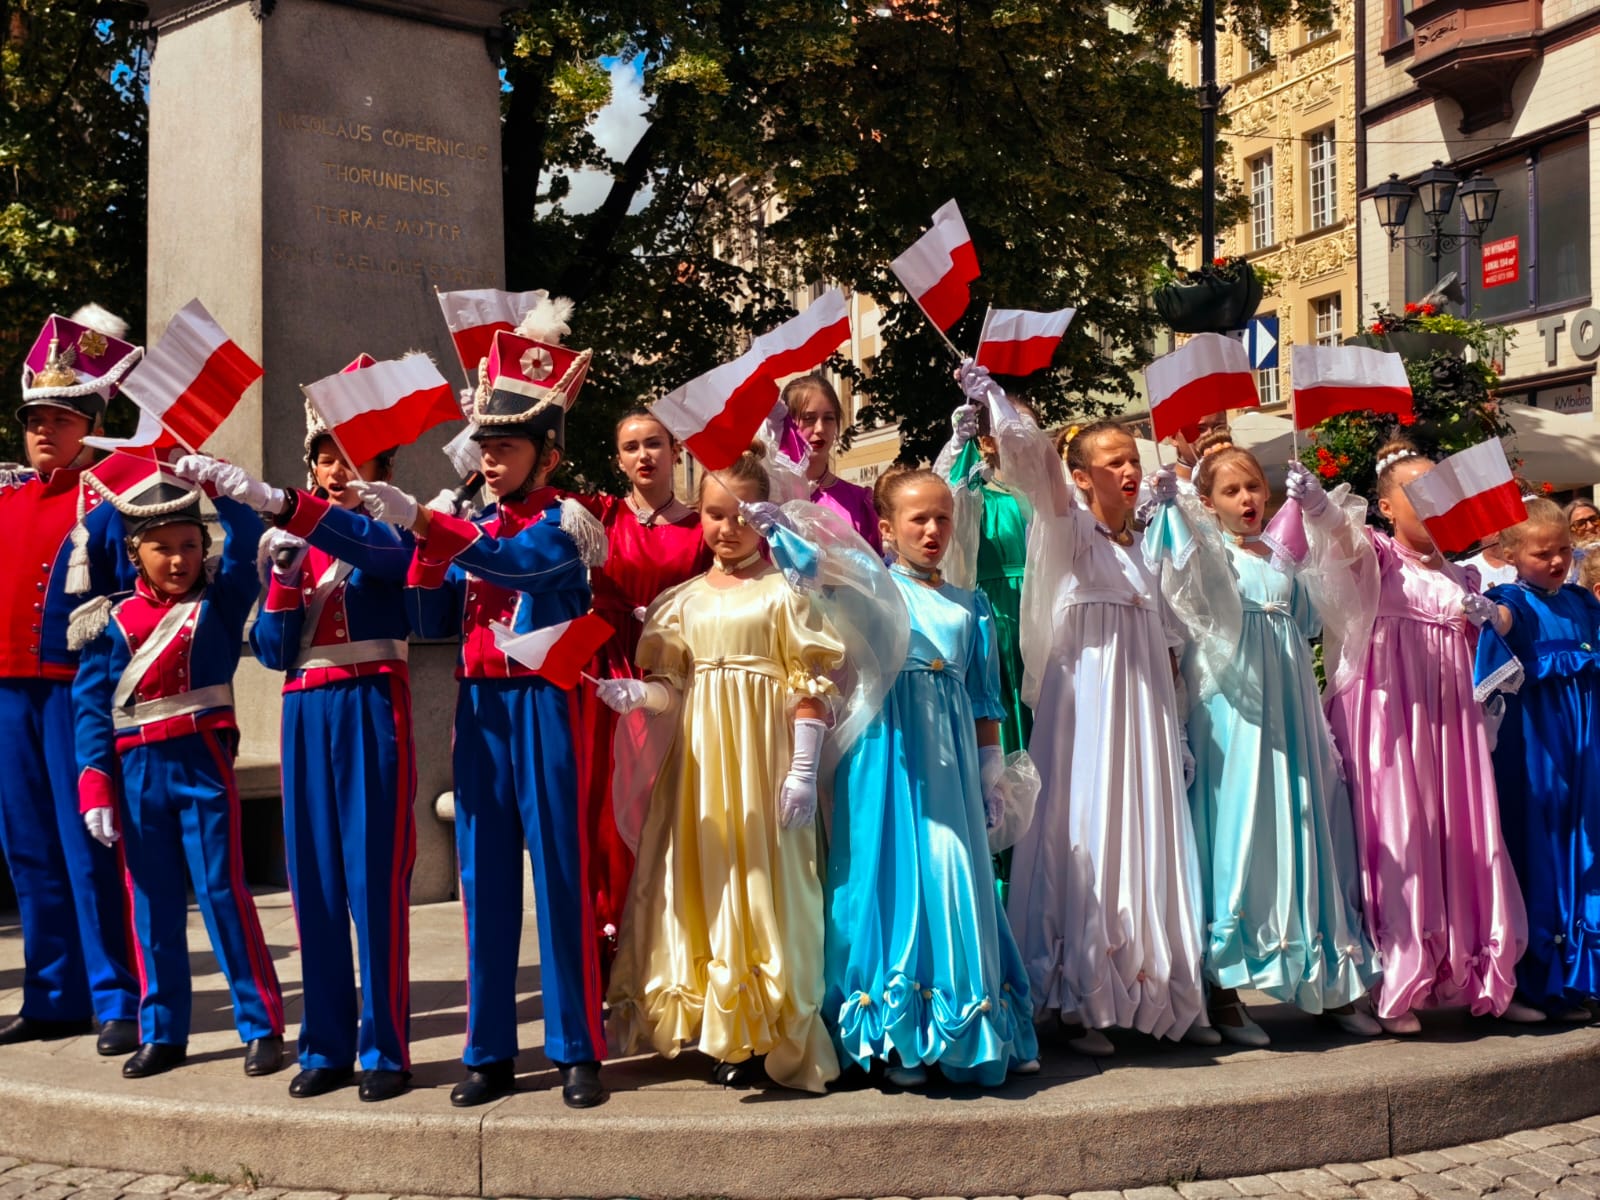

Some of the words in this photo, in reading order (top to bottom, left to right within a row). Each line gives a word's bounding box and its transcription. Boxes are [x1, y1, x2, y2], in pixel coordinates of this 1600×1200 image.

[278, 112, 372, 142] NICOLAUS
[381, 129, 488, 161] COPERNICUS
[321, 161, 451, 198] THORUNENSIS
[312, 205, 388, 231] TERRAE
